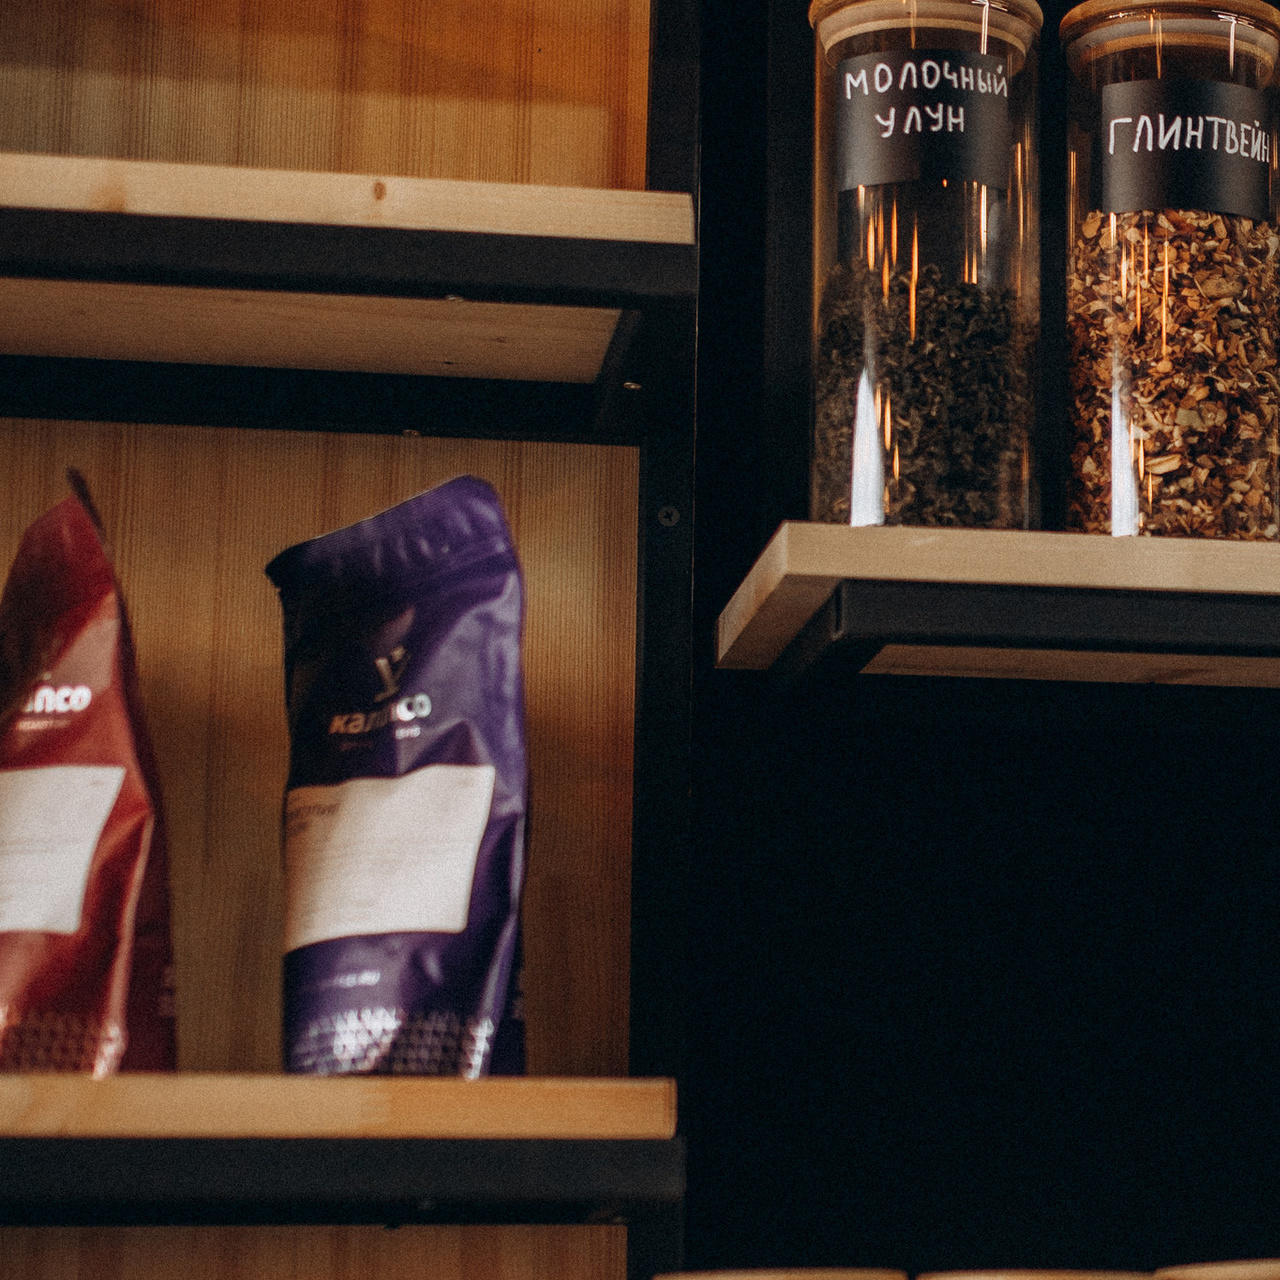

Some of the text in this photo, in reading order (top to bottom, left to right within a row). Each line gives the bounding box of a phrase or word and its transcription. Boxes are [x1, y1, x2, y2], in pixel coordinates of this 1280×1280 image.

[844, 60, 1009, 100] МОЛОЧНЫЙ
[874, 101, 966, 139] УЛУН
[1108, 113, 1271, 163] ГЛИНТВЕЙН
